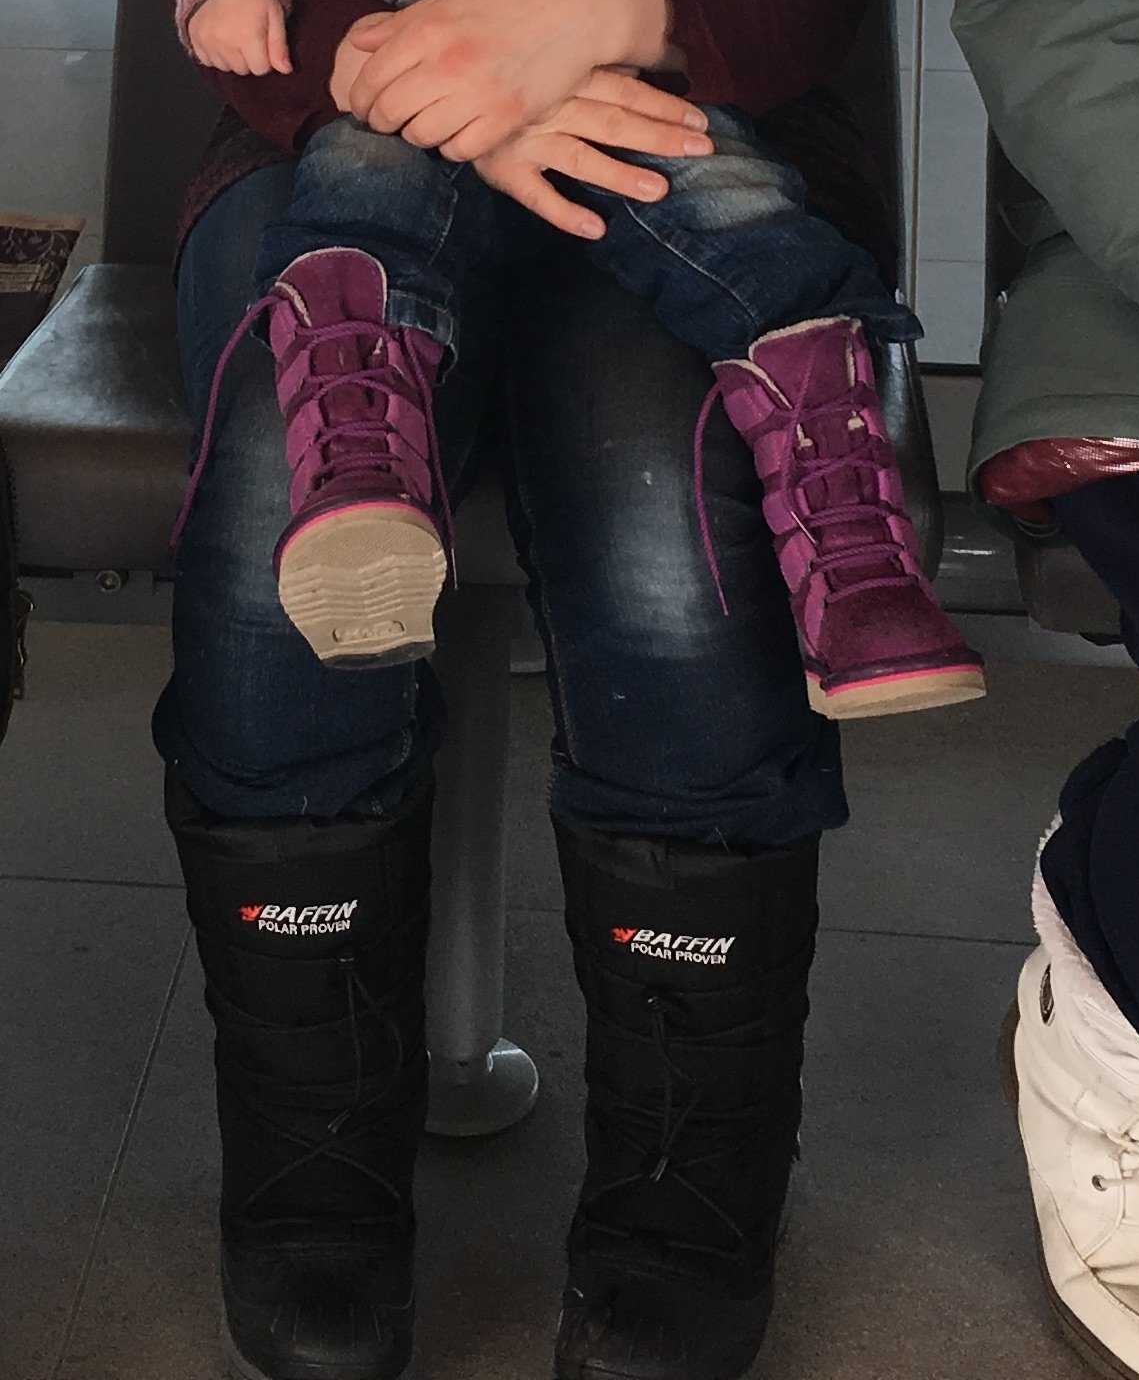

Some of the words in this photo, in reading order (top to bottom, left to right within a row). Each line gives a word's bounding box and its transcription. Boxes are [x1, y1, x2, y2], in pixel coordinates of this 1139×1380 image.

[259, 899, 358, 924] BAFFIN
[257, 919, 298, 935] POLAR
[300, 919, 351, 936] PROVEN
[630, 942, 672, 960] POLAR
[675, 950, 727, 965] PROVEN
[632, 929, 737, 954] BAFFIN
